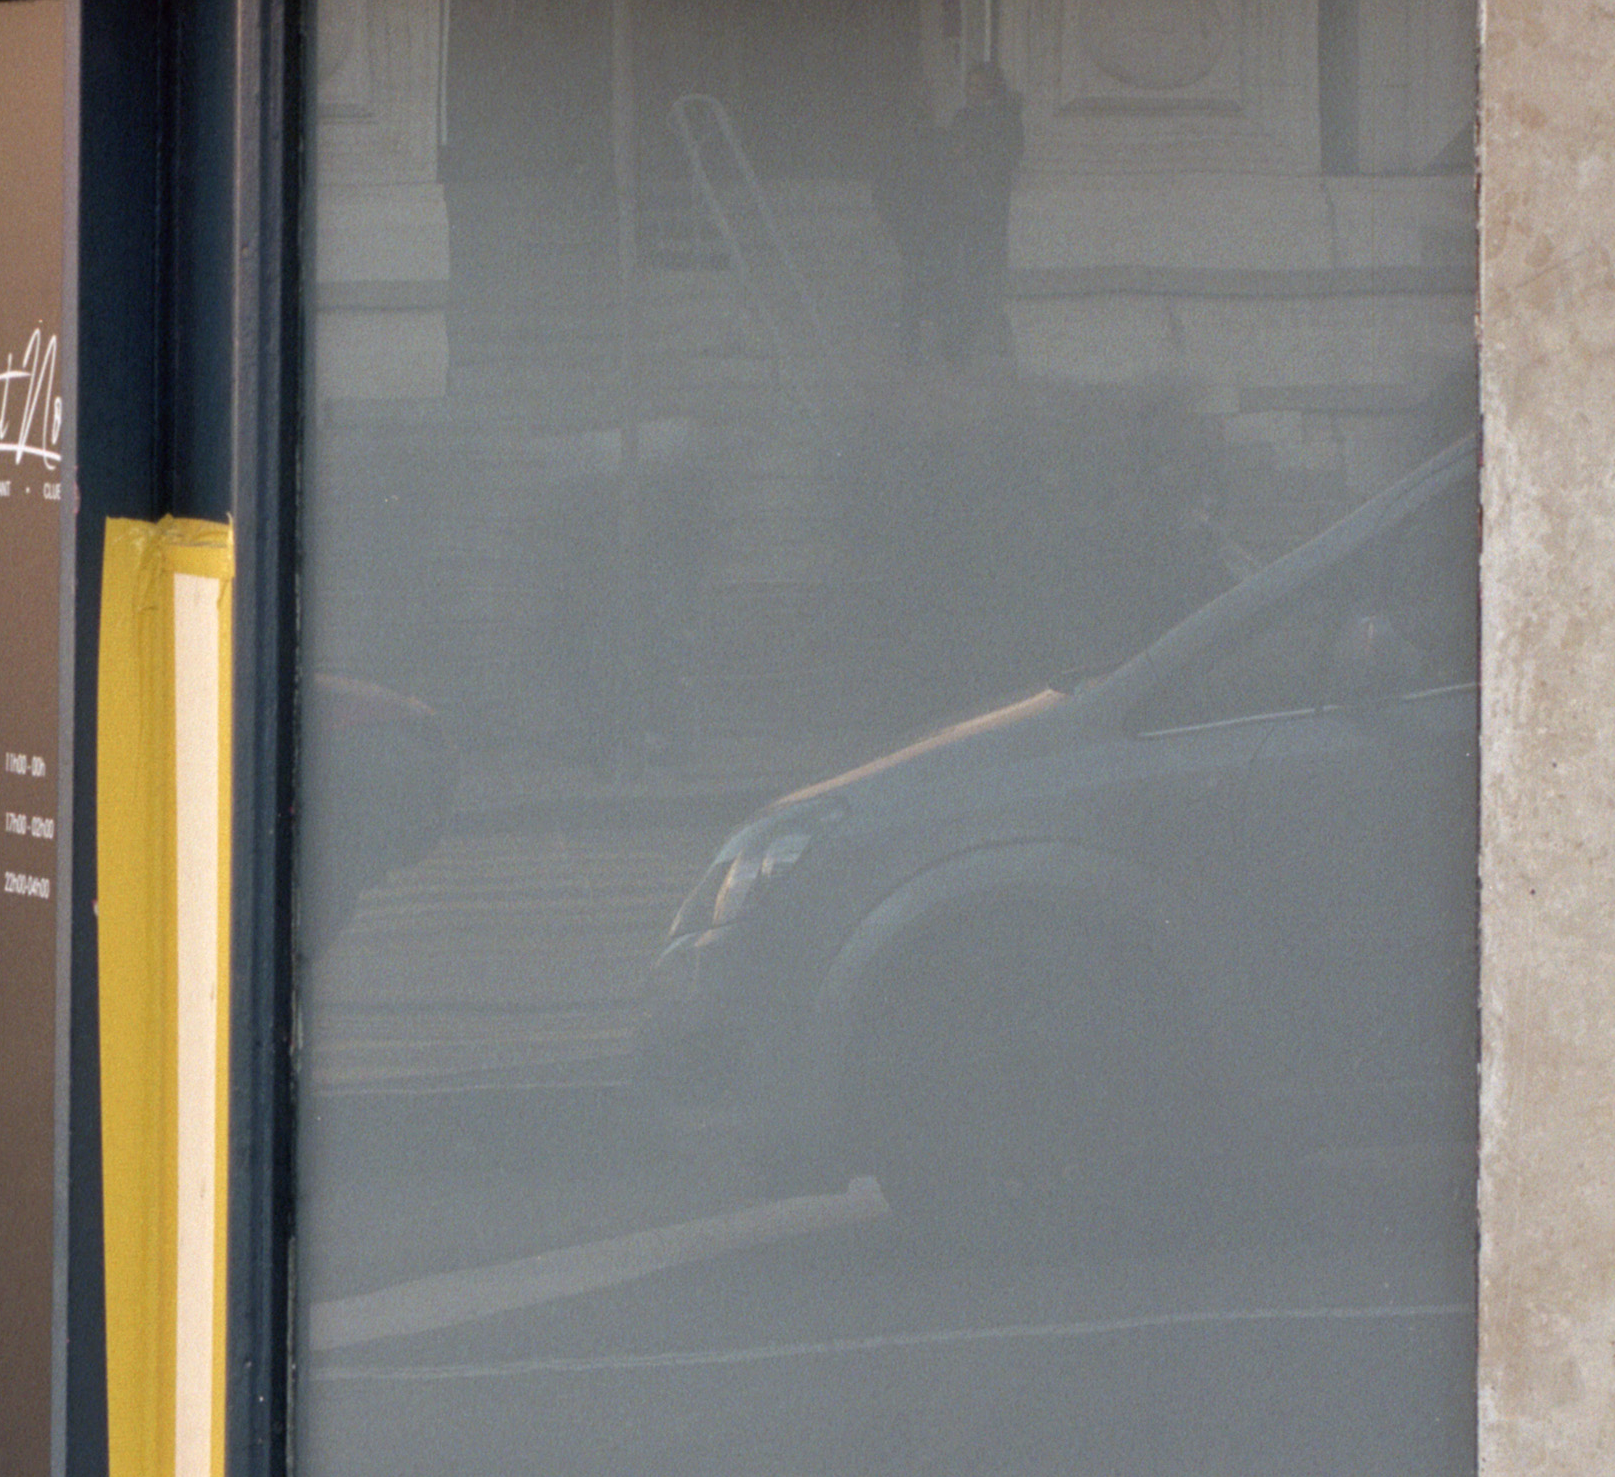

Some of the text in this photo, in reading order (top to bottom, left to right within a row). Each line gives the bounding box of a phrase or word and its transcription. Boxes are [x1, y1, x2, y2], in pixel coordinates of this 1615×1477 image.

[16, 328, 62, 470] No
[5, 751, 27, 775] 11h00
[5, 812, 27, 835] 17h00
